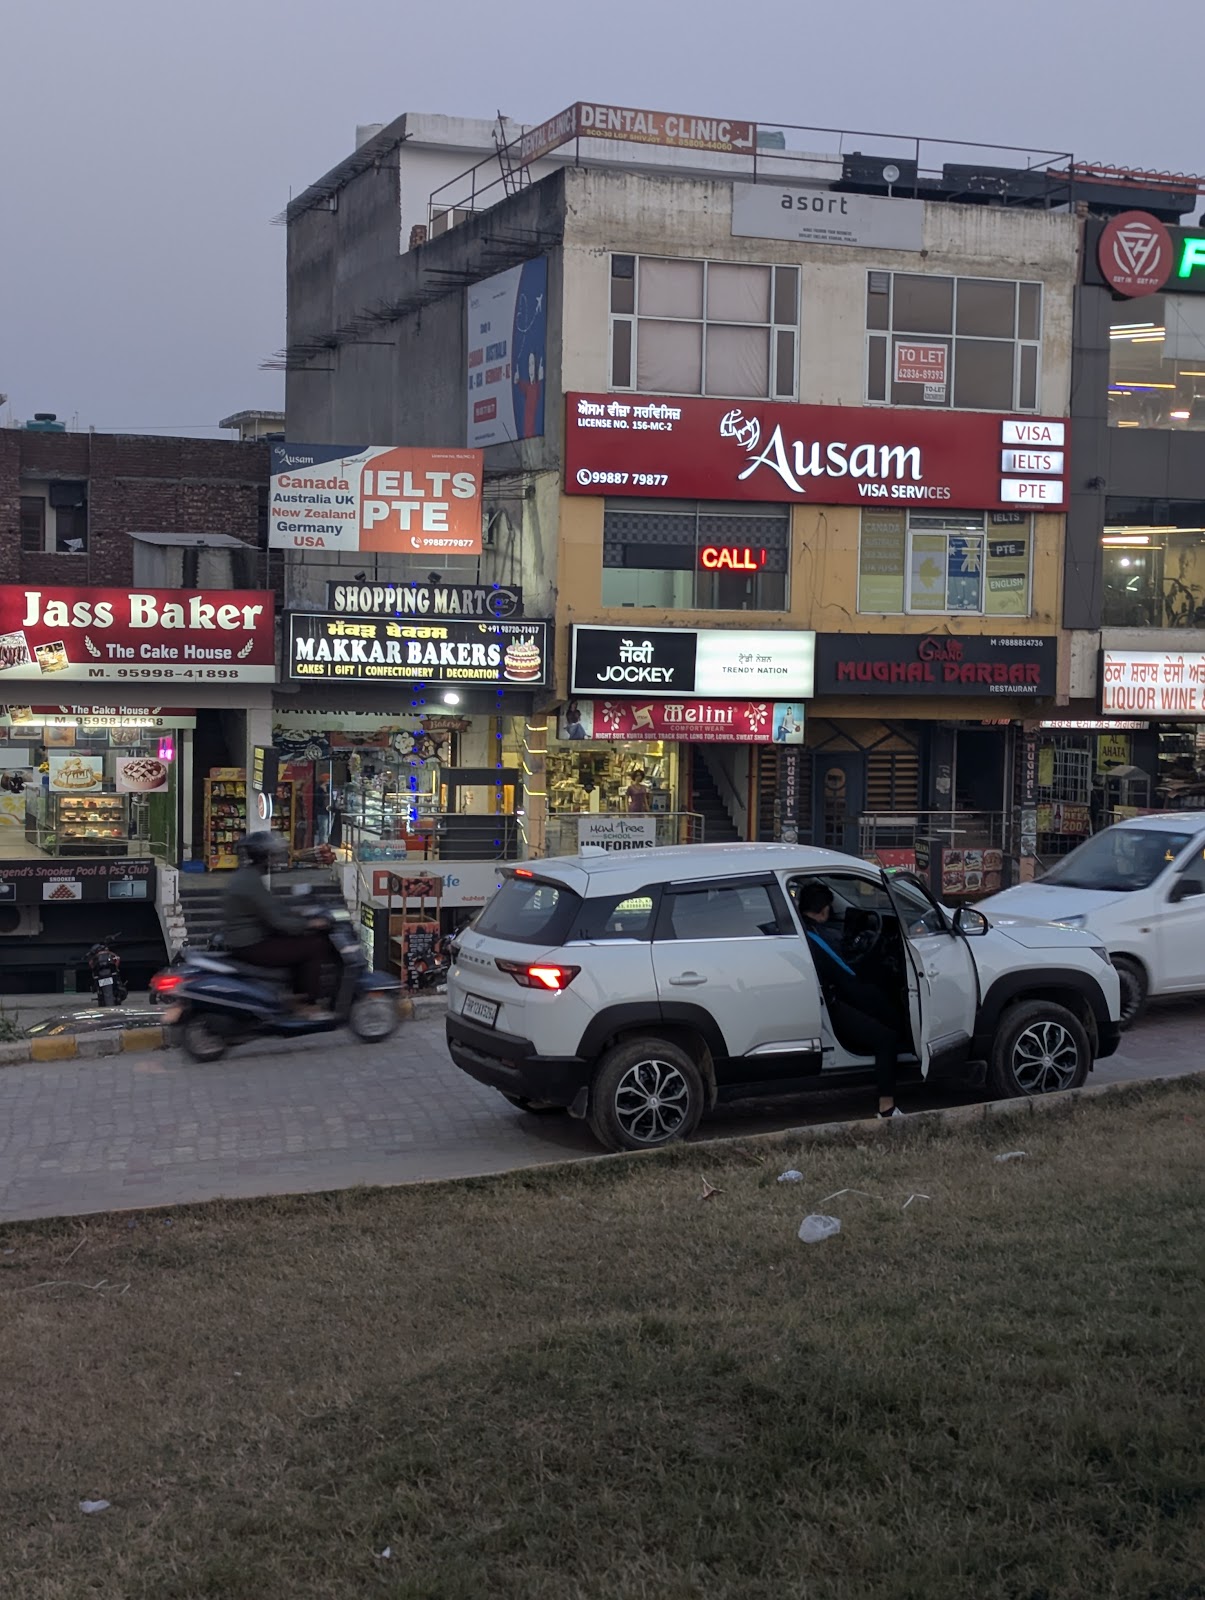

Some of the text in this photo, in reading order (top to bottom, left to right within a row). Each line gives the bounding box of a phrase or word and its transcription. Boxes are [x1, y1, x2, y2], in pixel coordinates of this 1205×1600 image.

[581, 104, 732, 143] DENTAL CLINIC
[781, 194, 848, 215] asort
[900, 349, 944, 363] TO LET
[578, 418, 672, 431] LICENSE NO. 156-MC-2
[1016, 426, 1051, 441] VISA
[280, 454, 314, 465] Ausam
[738, 424, 923, 493] Ausam
[1013, 454, 1051, 470] IELTS
[278, 475, 349, 490] Canada
[363, 470, 476, 498] IELTS
[592, 472, 668, 486] 99887 79877
[858, 483, 950, 499] VISA SERVICES
[1019, 483, 1046, 499] PTE
[273, 493, 354, 505] Australia UK
[272, 508, 356, 519] New Zealand
[363, 501, 449, 531] PTE
[993, 512, 1020, 522] IELTS
[277, 521, 343, 536] Germany
[294, 536, 325, 547] USA
[423, 538, 473, 547] 9988779877
[996, 545, 1016, 555] PTE
[702, 548, 757, 569] CALL
[990, 578, 1023, 589] ENGLISH
[334, 586, 485, 615] SHOPPING MART
[22, 592, 263, 630] Jass Baker
[106, 643, 232, 660] The Cake House
[296, 638, 500, 666] MAKKAR BAKERS
[88, 668, 239, 679] M. 95998-41898
[297, 664, 499, 679] CAKES GIFT CONFECTIONERY DECORATION
[597, 666, 674, 683] JOCKEY
[722, 666, 754, 674] TRENDY
[837, 662, 1041, 684] MUGHAL DARBAR
[1104, 654, 1126, 683] ਠੇਕਾ
[1164, 656, 1184, 683] ਦੇਸੀ
[1104, 686, 1155, 711] LIQUOR
[1161, 687, 1196, 710] WINE
[71, 705, 149, 715] The Cake House
[663, 704, 734, 723] Melini
[1102, 746, 1125, 758] AHATA
[1026, 743, 1036, 799] MUGHAL
[616, 821, 645, 834] Tree
[0, 867, 33, 878] egend's
[36, 866, 73, 877] Snooker
[76, 865, 97, 876] Pool
[99, 866, 107, 875] &
[128, 865, 149, 875] Club
[443, 874, 460, 887] ife
